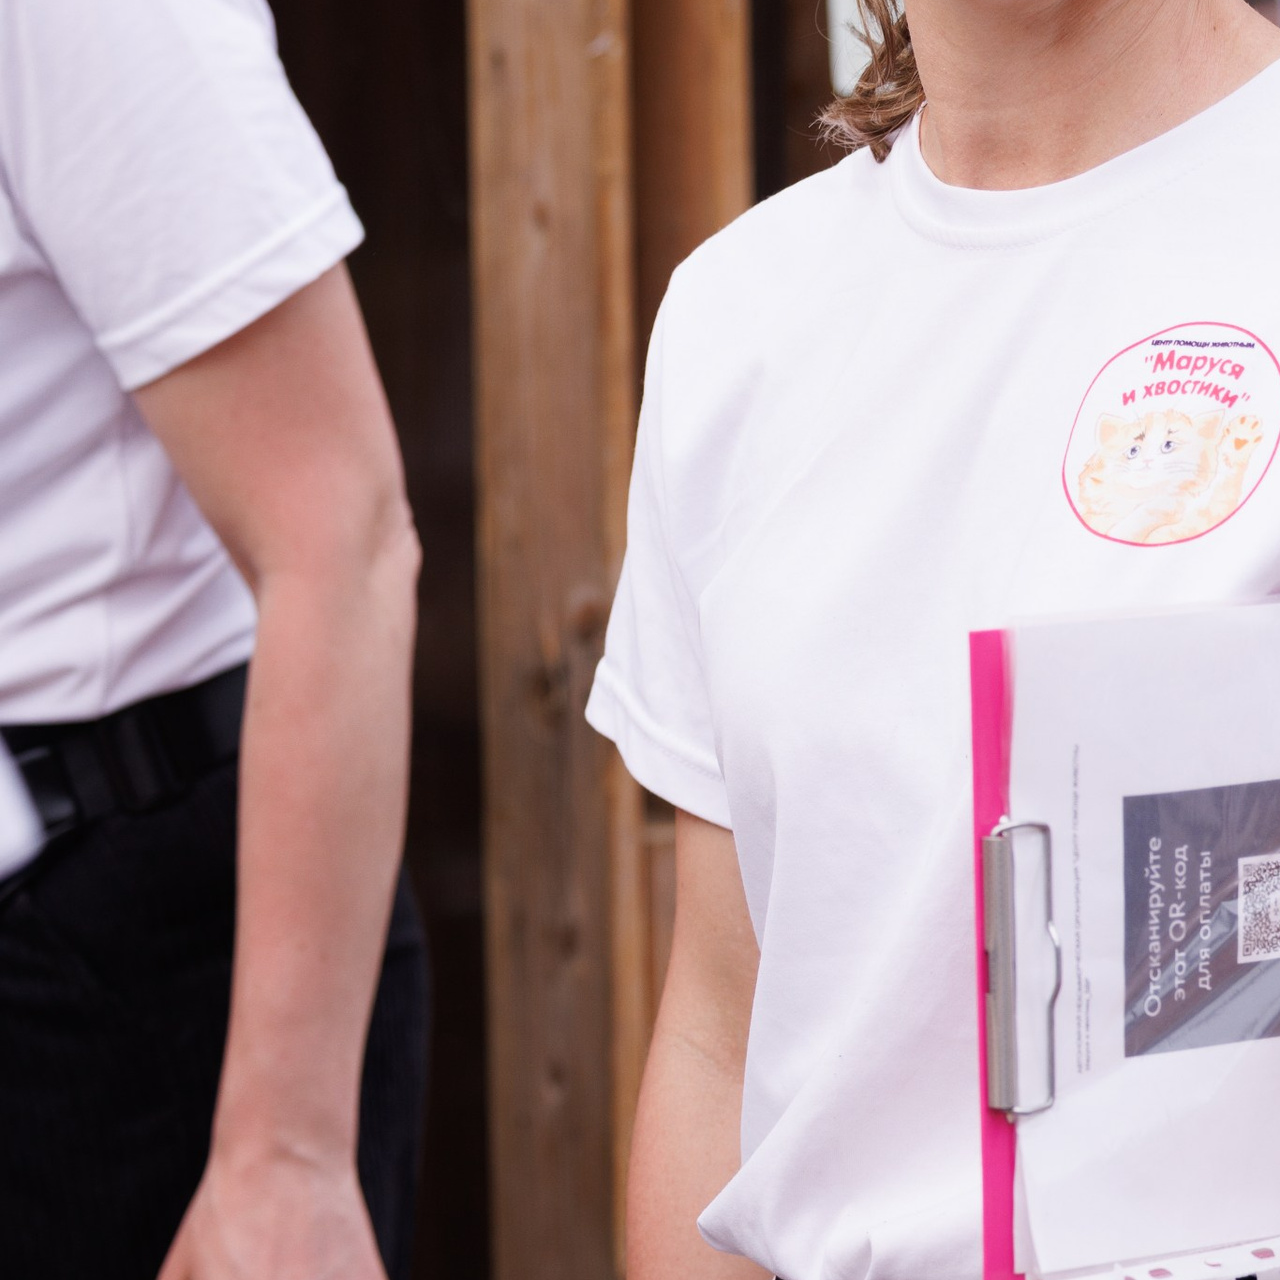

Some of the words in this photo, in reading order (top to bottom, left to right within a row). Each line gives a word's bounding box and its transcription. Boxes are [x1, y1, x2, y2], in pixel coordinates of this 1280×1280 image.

[1144, 350, 1245, 380] "Маруся
[1122, 390, 1136, 406] и
[1142, 380, 1251, 408] хвостики"
[1168, 845, 1188, 942] QR-код
[1198, 851, 1212, 940] оплаты
[1144, 837, 1165, 1017] Отсканируйте
[1172, 949, 1187, 1001] этот
[1197, 948, 1212, 990] для
